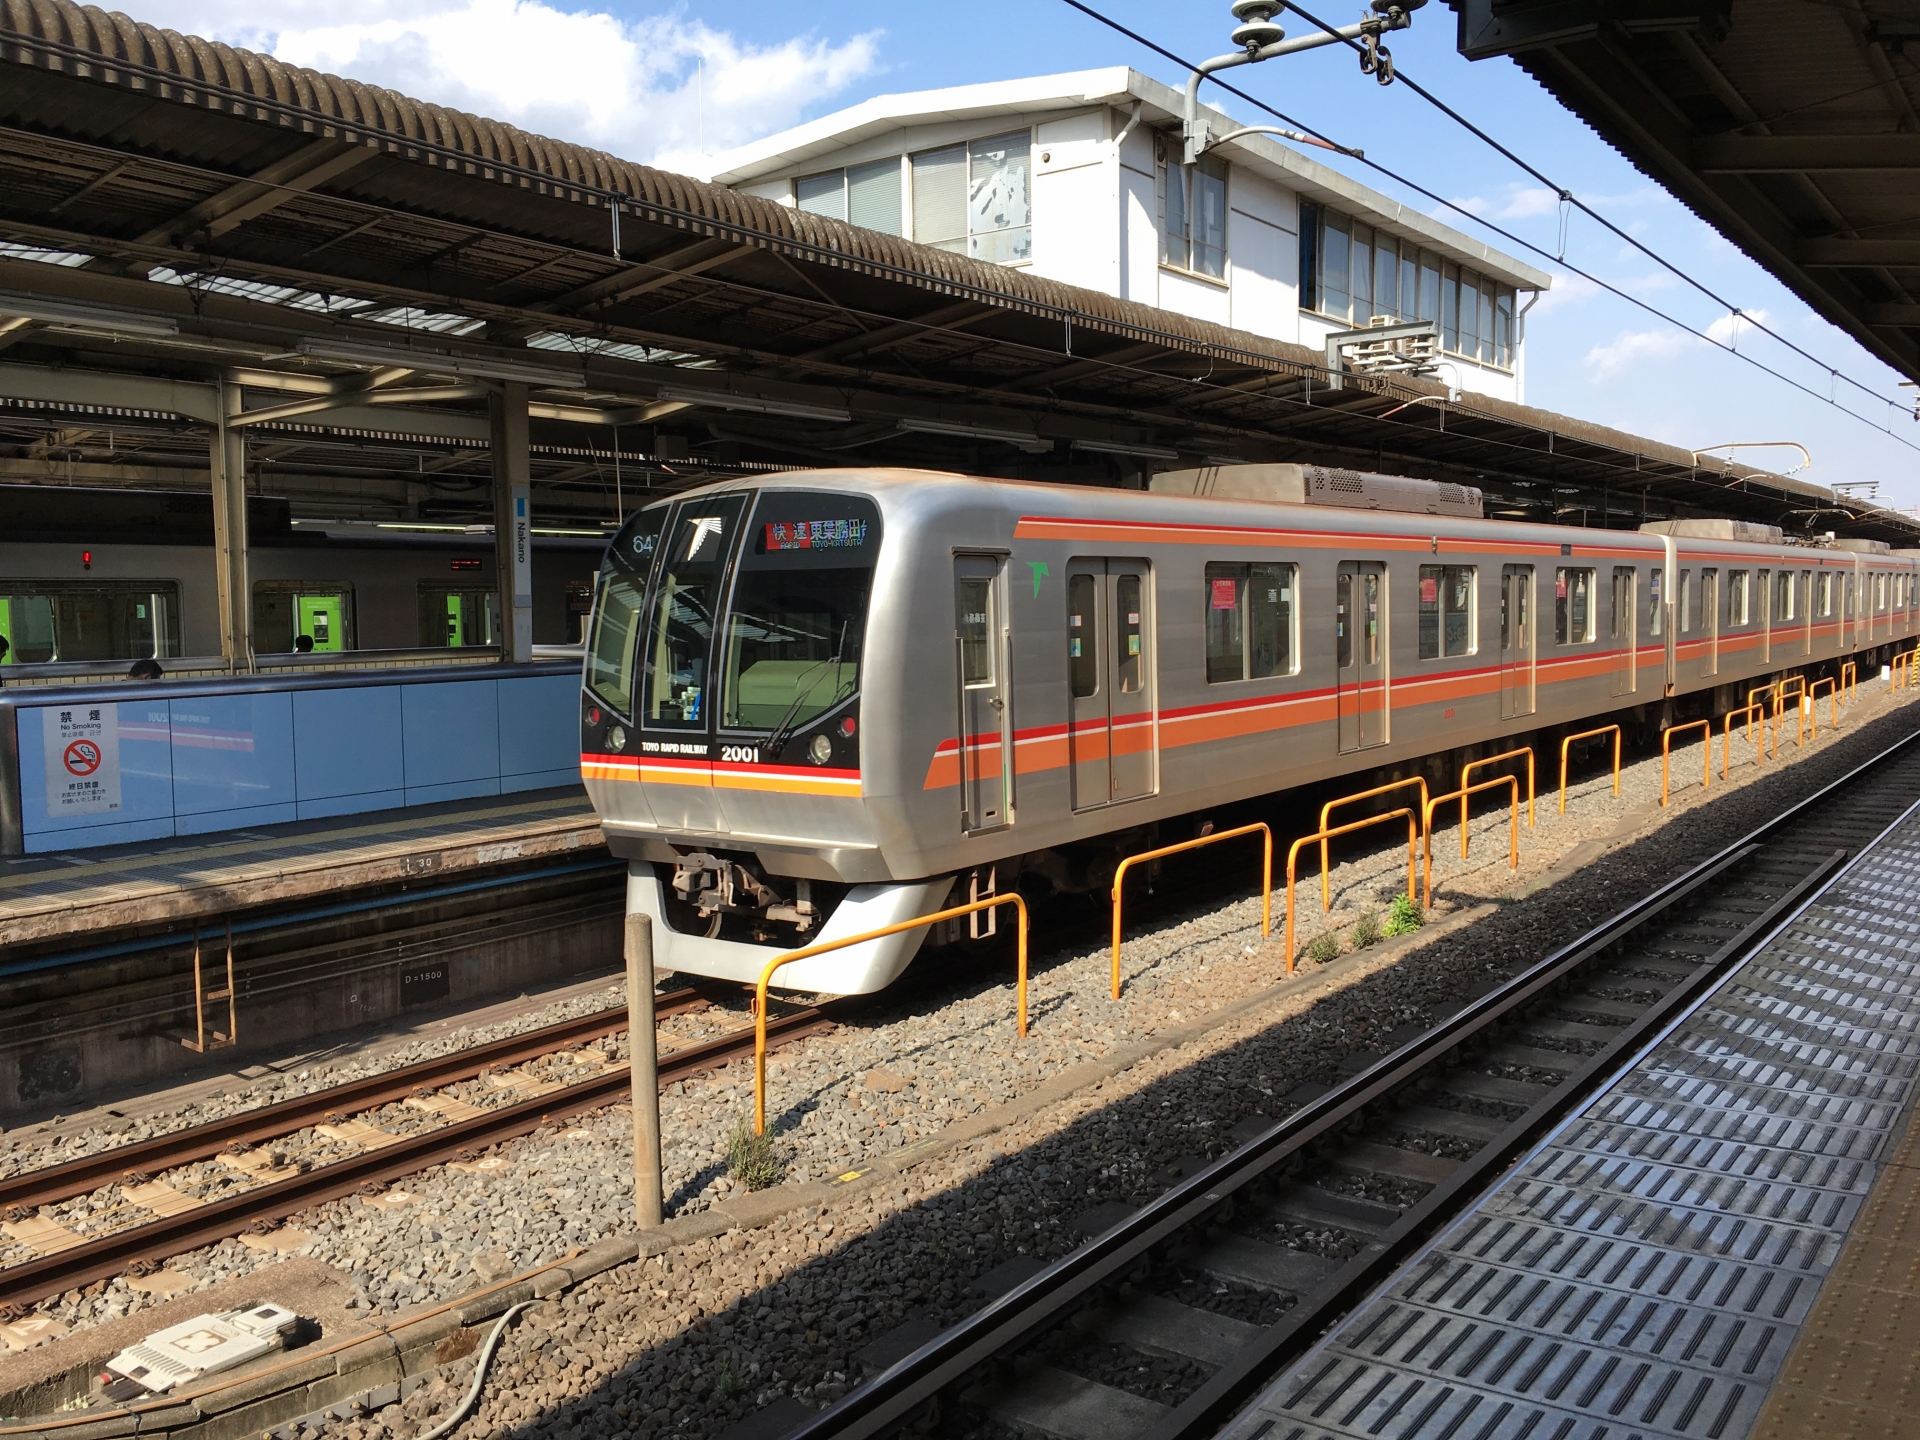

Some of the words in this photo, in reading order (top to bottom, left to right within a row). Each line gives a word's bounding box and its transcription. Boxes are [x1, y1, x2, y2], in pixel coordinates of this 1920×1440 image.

[773, 522, 807, 540] 快速
[781, 541, 800, 549] RAPID
[60, 709, 101, 723] 禁煙
[72, 722, 101, 730] Smoking
[642, 742, 659, 751] TOYO
[661, 743, 679, 753] RAPID
[680, 744, 708, 754] RAILWAY
[721, 745, 759, 763] 2001
